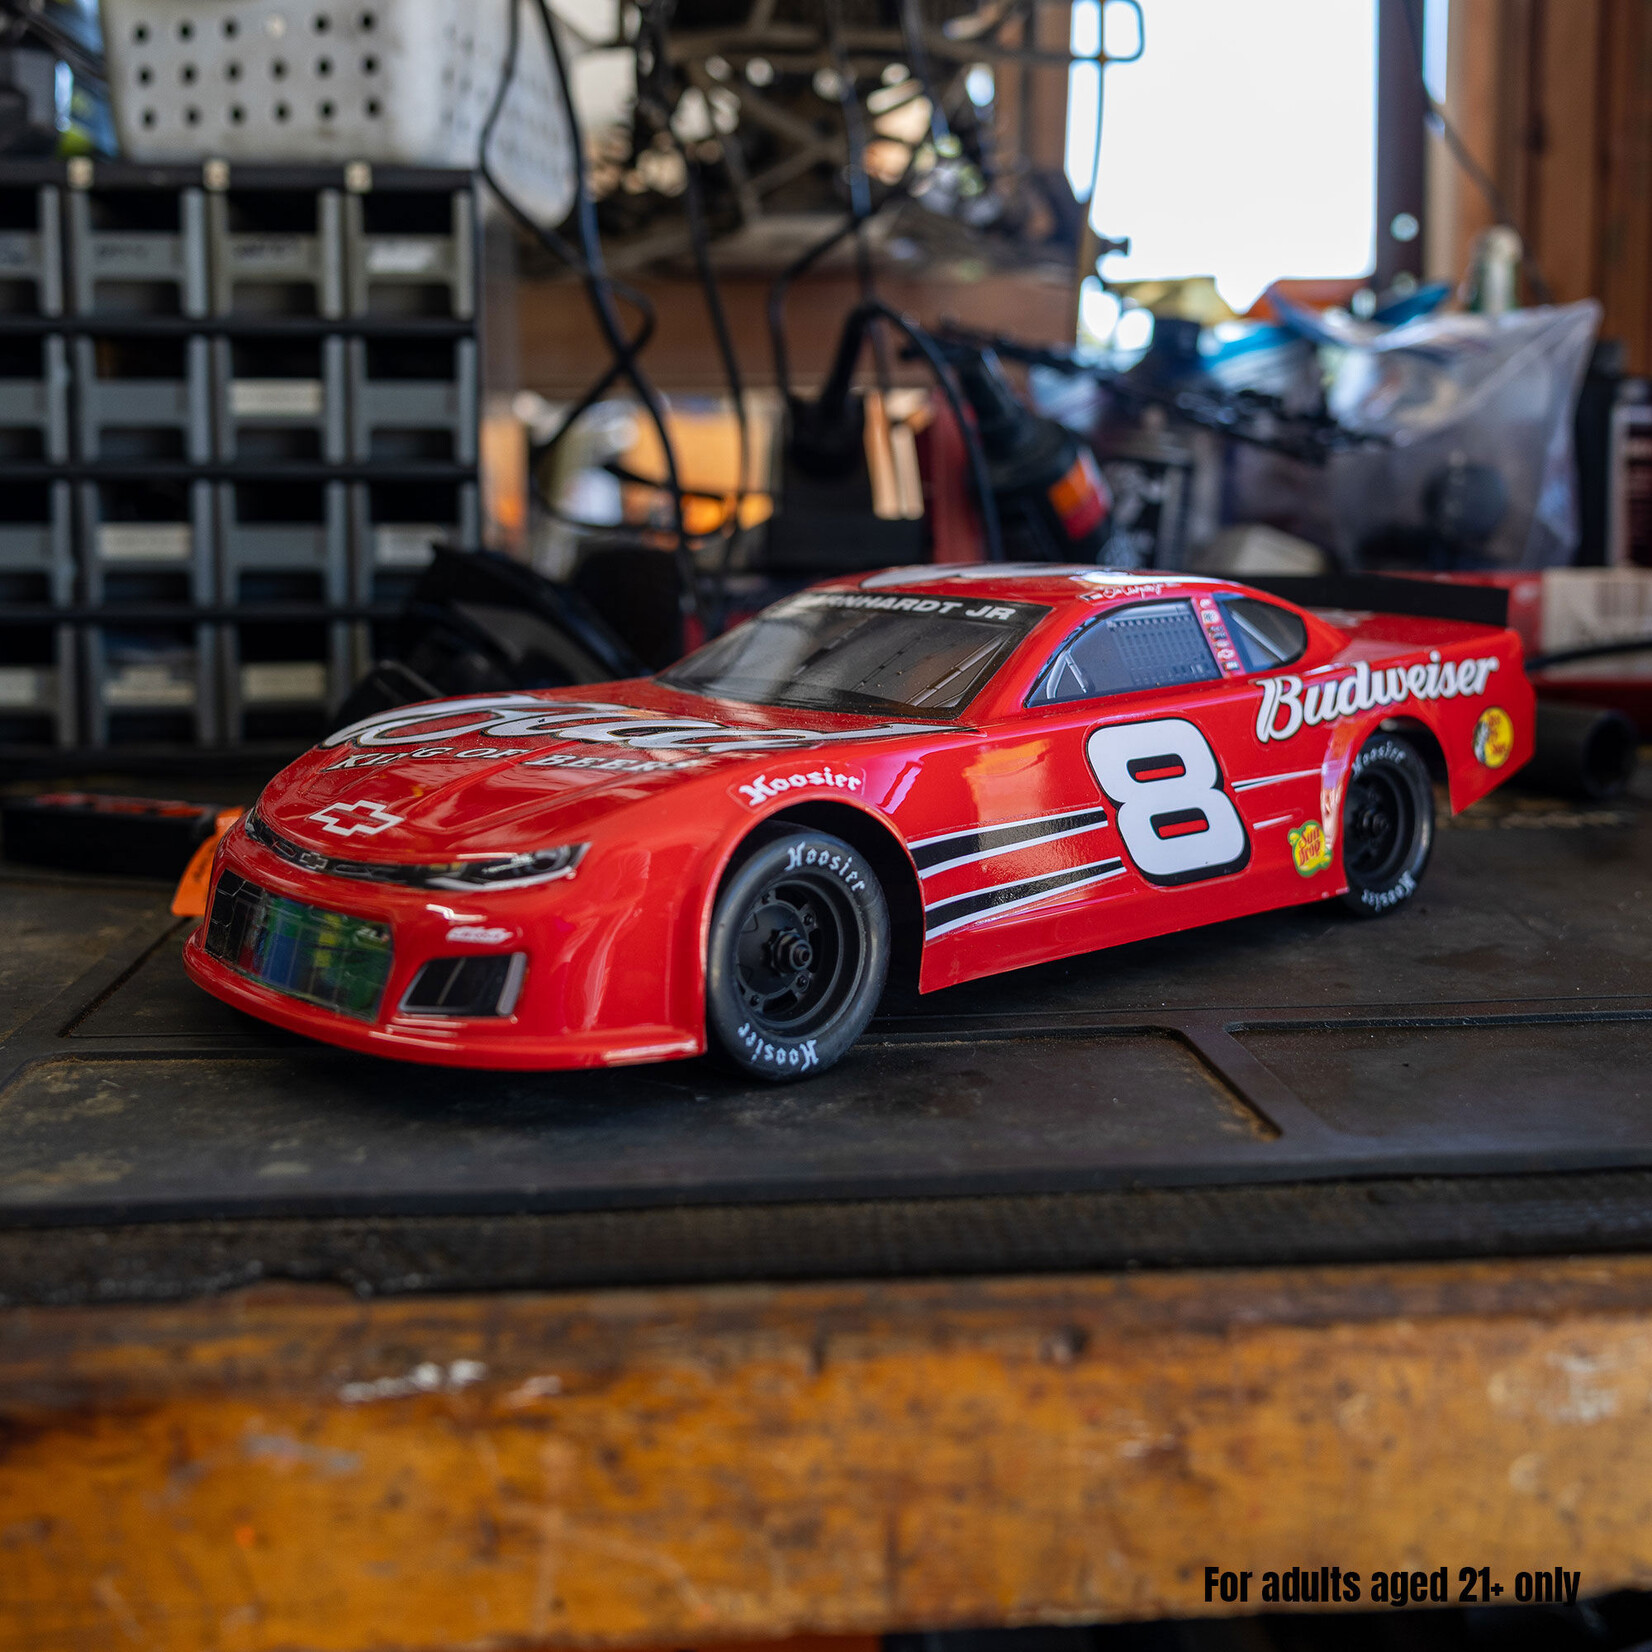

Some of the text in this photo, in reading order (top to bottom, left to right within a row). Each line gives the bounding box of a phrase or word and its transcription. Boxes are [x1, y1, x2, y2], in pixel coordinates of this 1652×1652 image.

[965, 606, 1016, 620] JR
[1256, 650, 1500, 744] Budweiser
[455, 748, 532, 759] OF
[1350, 740, 1407, 781] Hoosier
[738, 766, 862, 807] Hoosier
[1085, 716, 1251, 887] 8
[784, 841, 866, 892] Hoosier
[1361, 870, 1416, 912] Hoosier
[737, 1022, 819, 1072] Hoosier
